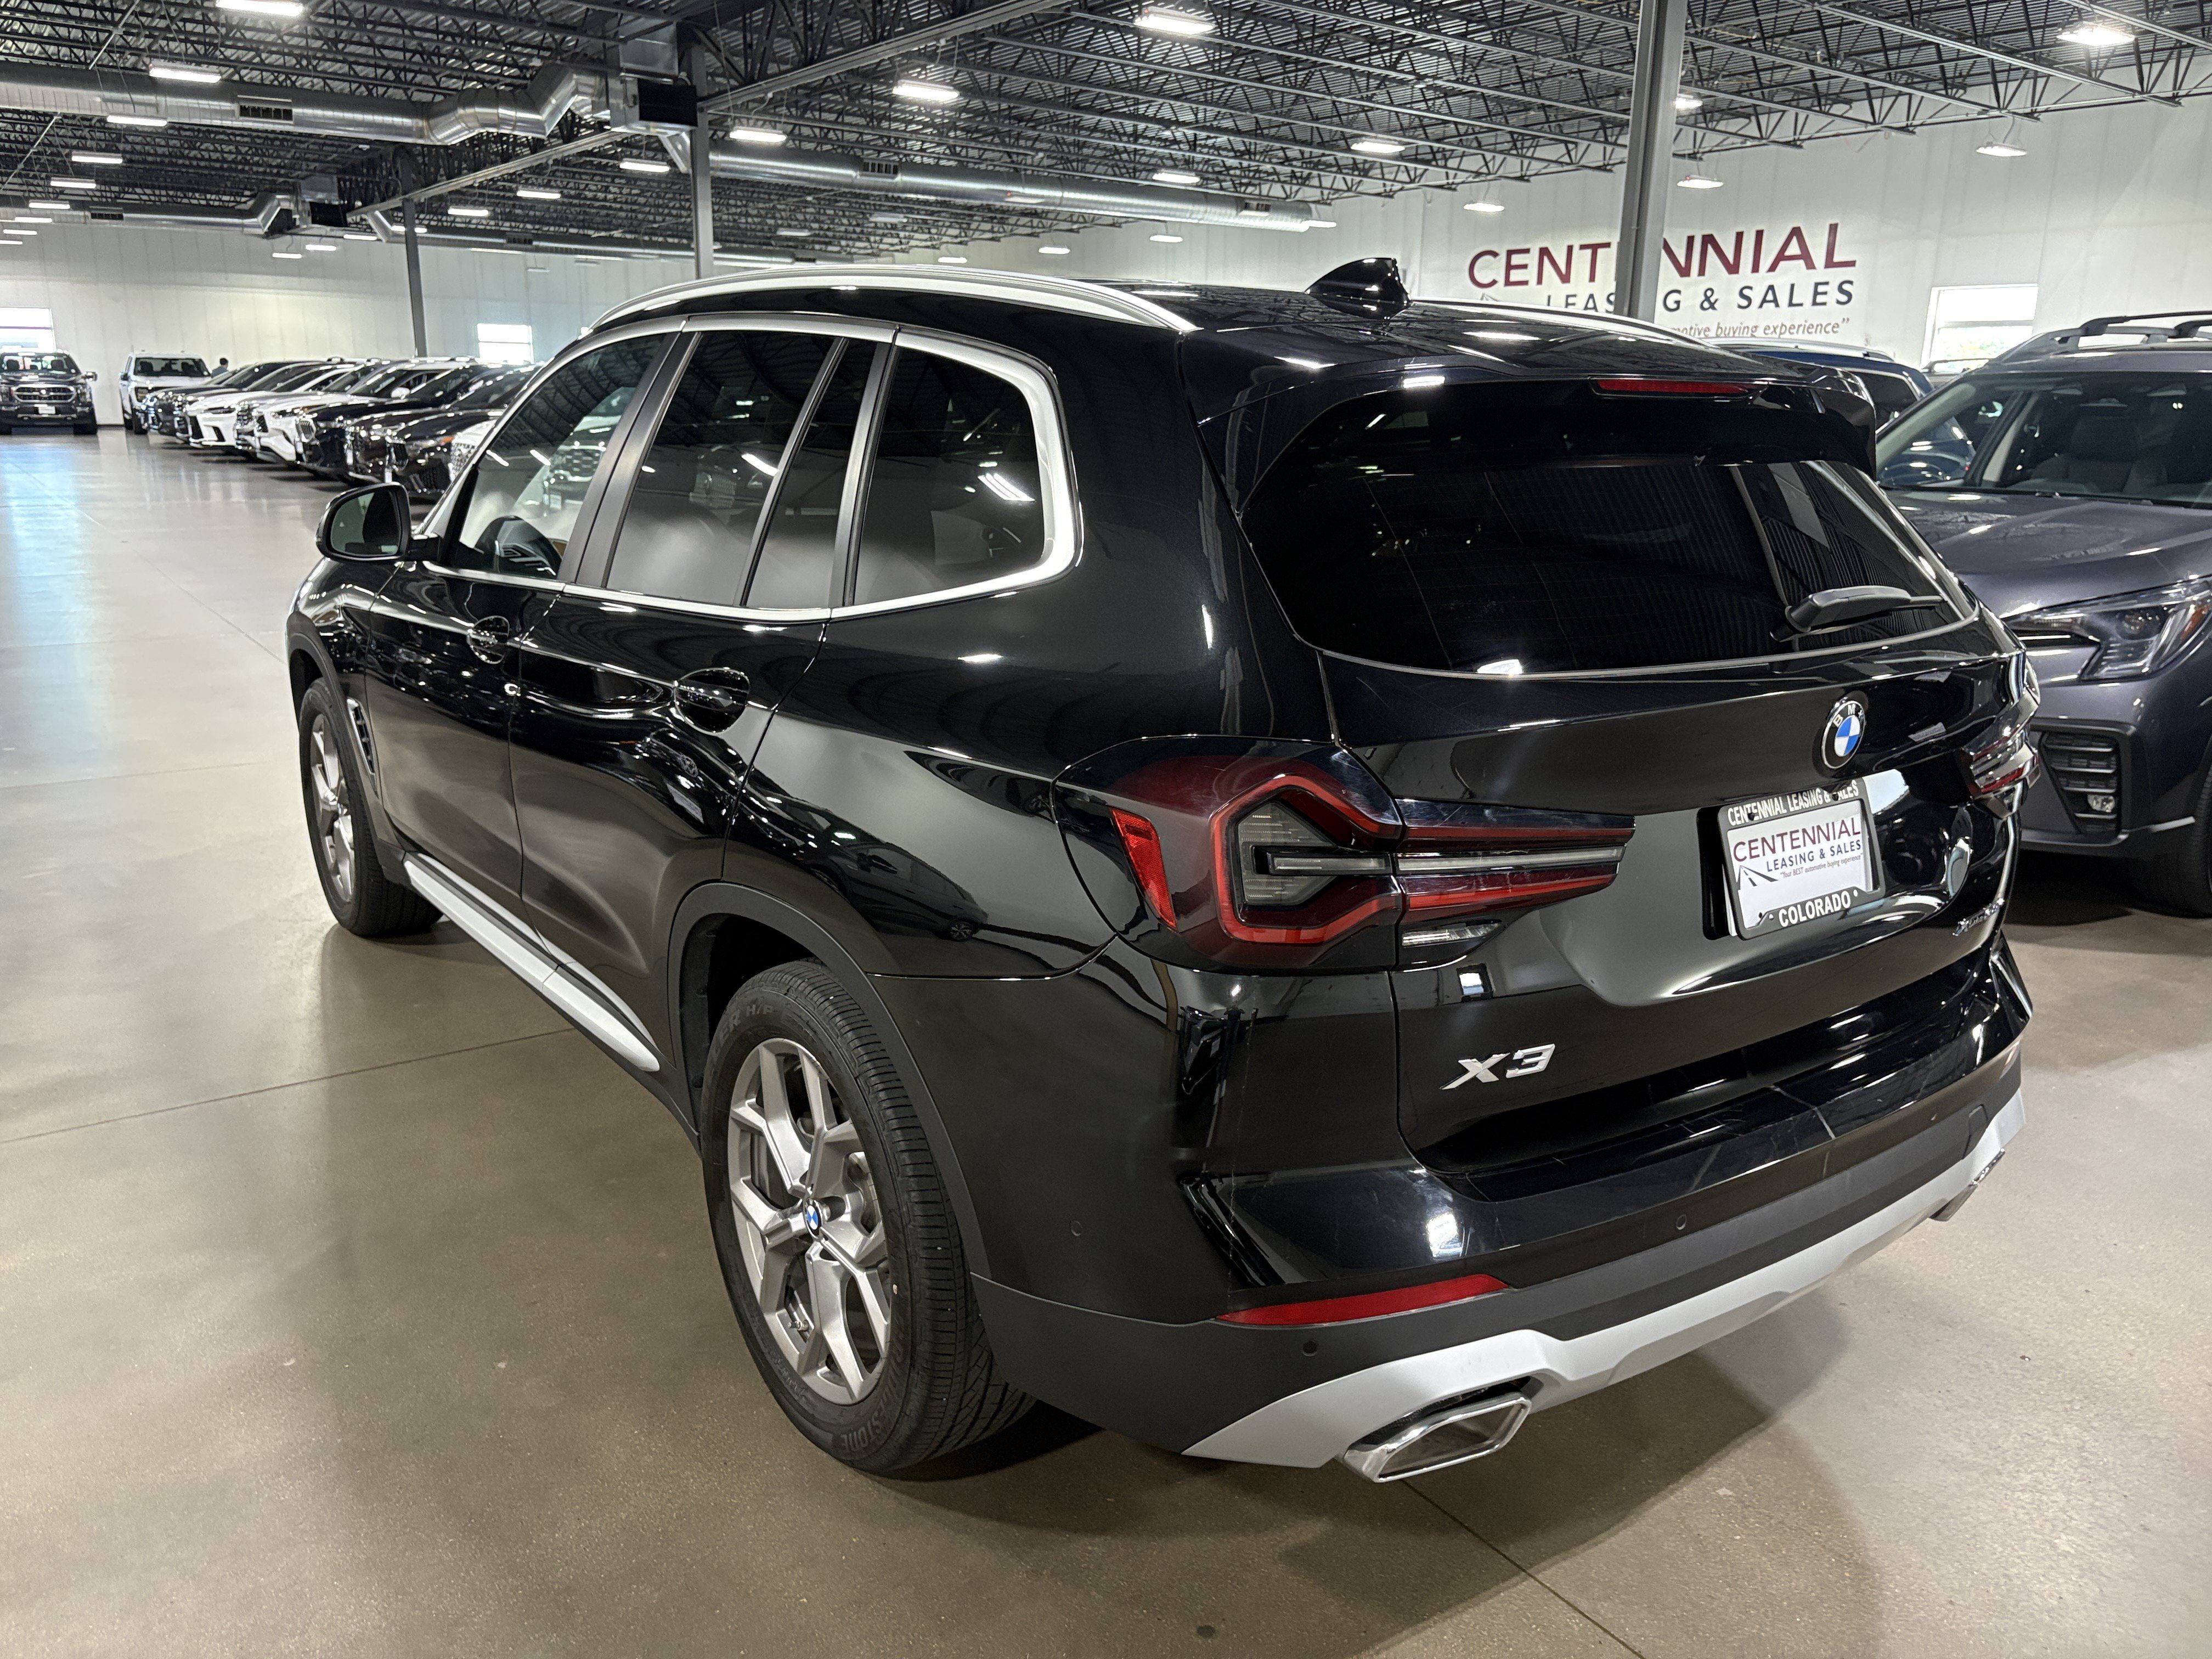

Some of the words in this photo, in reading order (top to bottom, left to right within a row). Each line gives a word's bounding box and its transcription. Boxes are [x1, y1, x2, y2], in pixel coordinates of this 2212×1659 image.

[1468, 222, 1857, 289] CENTNNIAL
[1700, 287, 1718, 311] &
[1737, 280, 1854, 309] SALES
[1787, 788, 1823, 811] LEASING
[1832, 780, 1859, 800] ALES
[1733, 817, 1861, 862] CENTENNIAL
[1767, 851, 1815, 872] LEASING
[1819, 848, 1826, 859] &
[1830, 839, 1861, 857] SALES
[1779, 890, 1851, 927] COLORADO
[1440, 1043, 1556, 1090] X3
